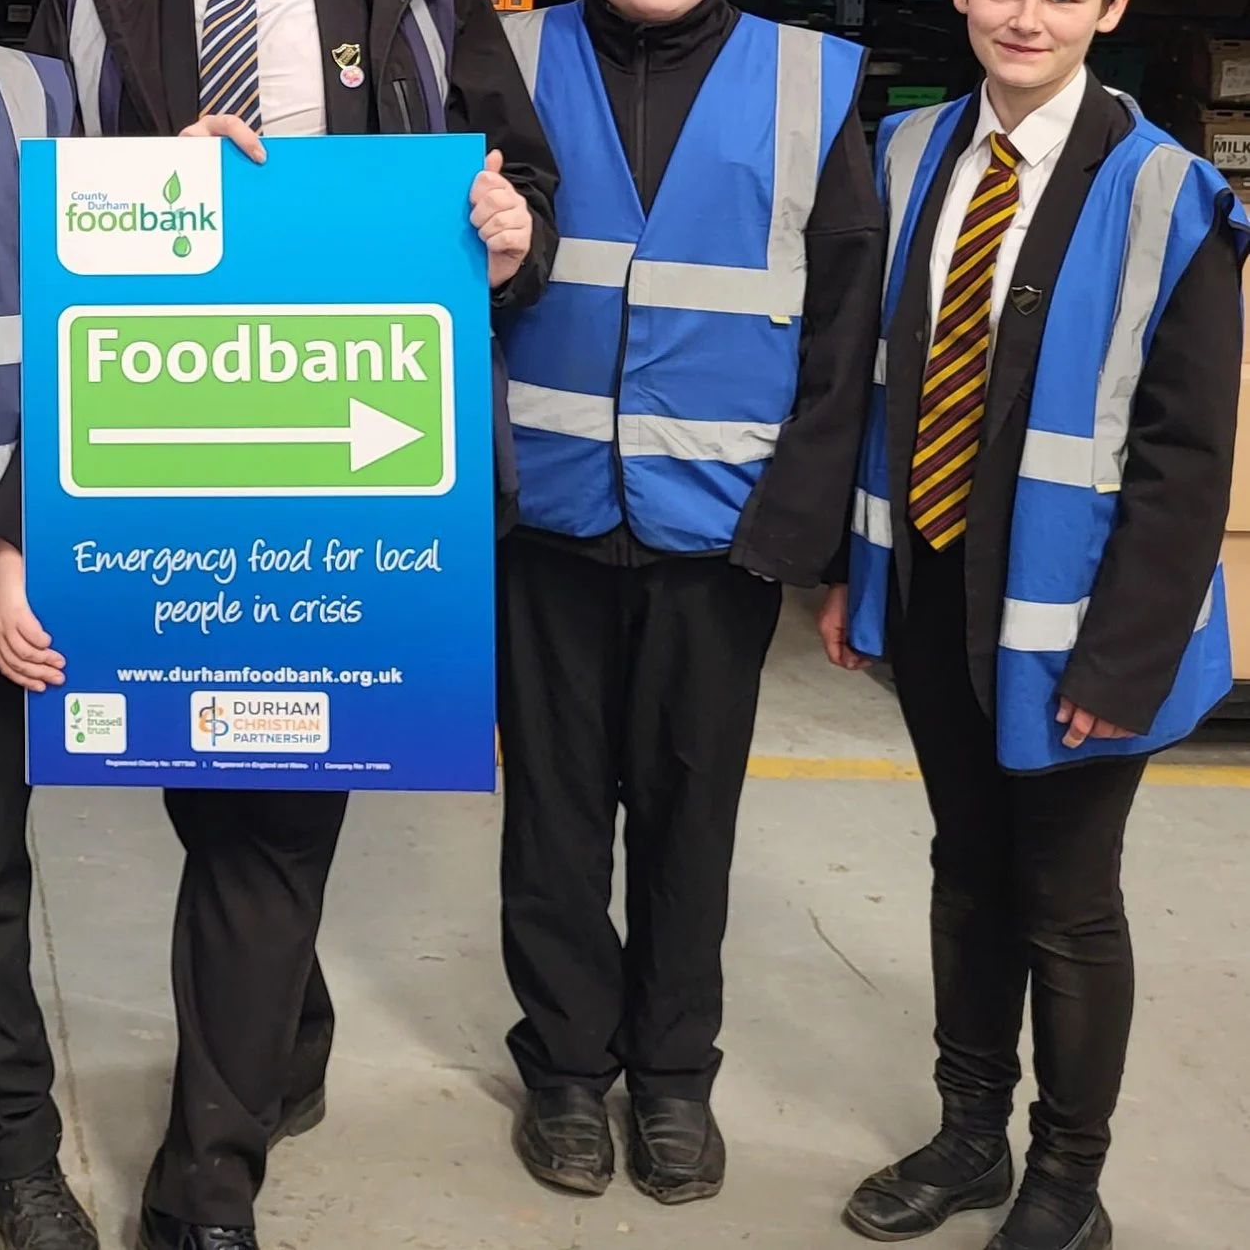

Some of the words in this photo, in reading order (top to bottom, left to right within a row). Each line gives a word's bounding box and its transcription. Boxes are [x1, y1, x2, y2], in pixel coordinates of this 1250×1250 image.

[71, 191, 108, 202] County
[87, 201, 129, 211] Durham
[65, 202, 218, 232] foodbank
[86, 322, 428, 384] Foodbank
[72, 540, 238, 585] Emergency
[248, 538, 312, 573] food
[322, 539, 364, 574] for
[375, 538, 442, 573] local
[154, 590, 243, 635] people
[253, 594, 280, 623] in
[289, 594, 363, 623] crisis
[116, 665, 403, 687] www.durhamfoodbank.org.uk
[87, 708, 104, 718] the
[233, 701, 321, 716] DURHAM
[87, 716, 123, 726] trussell
[233, 717, 320, 731] CHRISTIAN
[87, 726, 111, 735] trust
[233, 733, 322, 744] PARTNERSHIP
